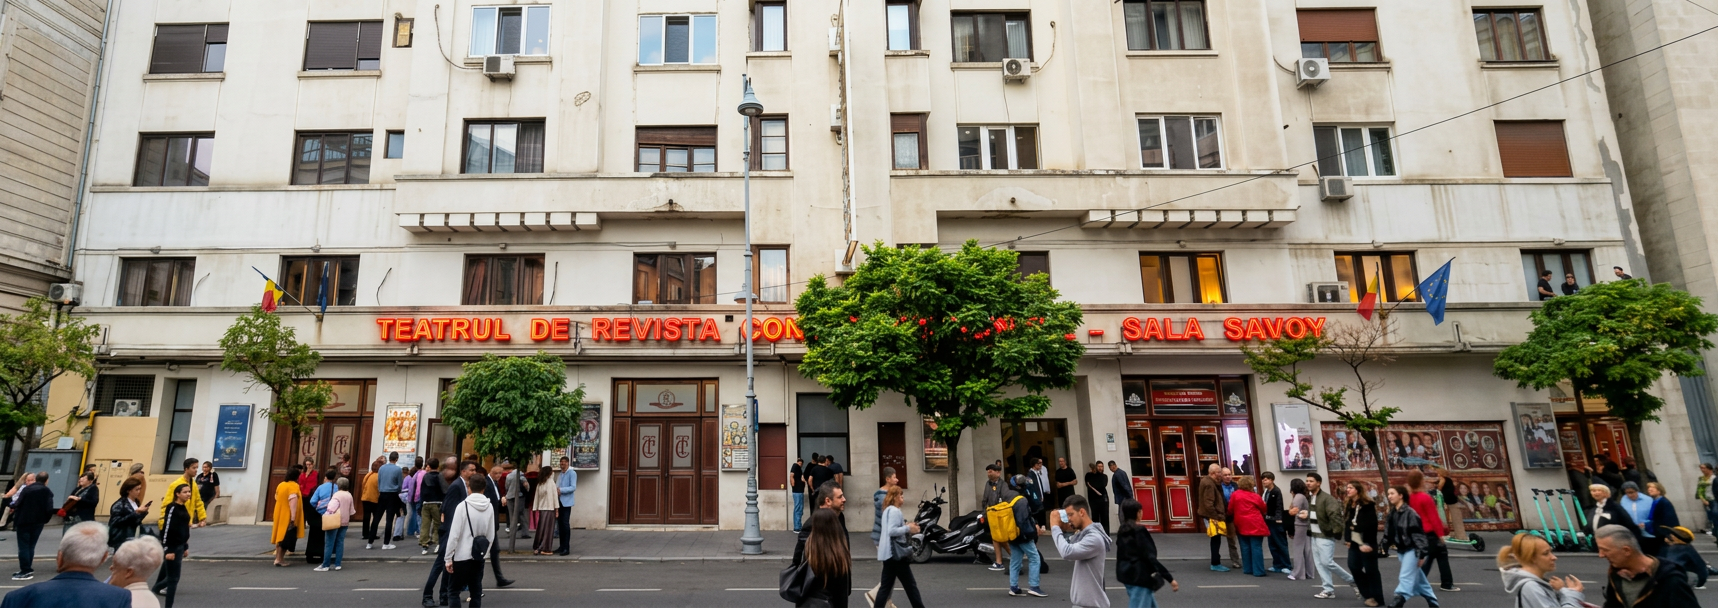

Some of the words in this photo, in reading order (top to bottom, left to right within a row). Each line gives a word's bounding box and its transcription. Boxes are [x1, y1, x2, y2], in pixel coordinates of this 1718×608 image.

[377, 317, 511, 342] TEATRUL
[530, 317, 570, 342] DE
[591, 317, 721, 342] REVISTA
[741, 316, 804, 342] CON
[1122, 316, 1205, 342] SALA
[1223, 316, 1327, 342] SAVOY
